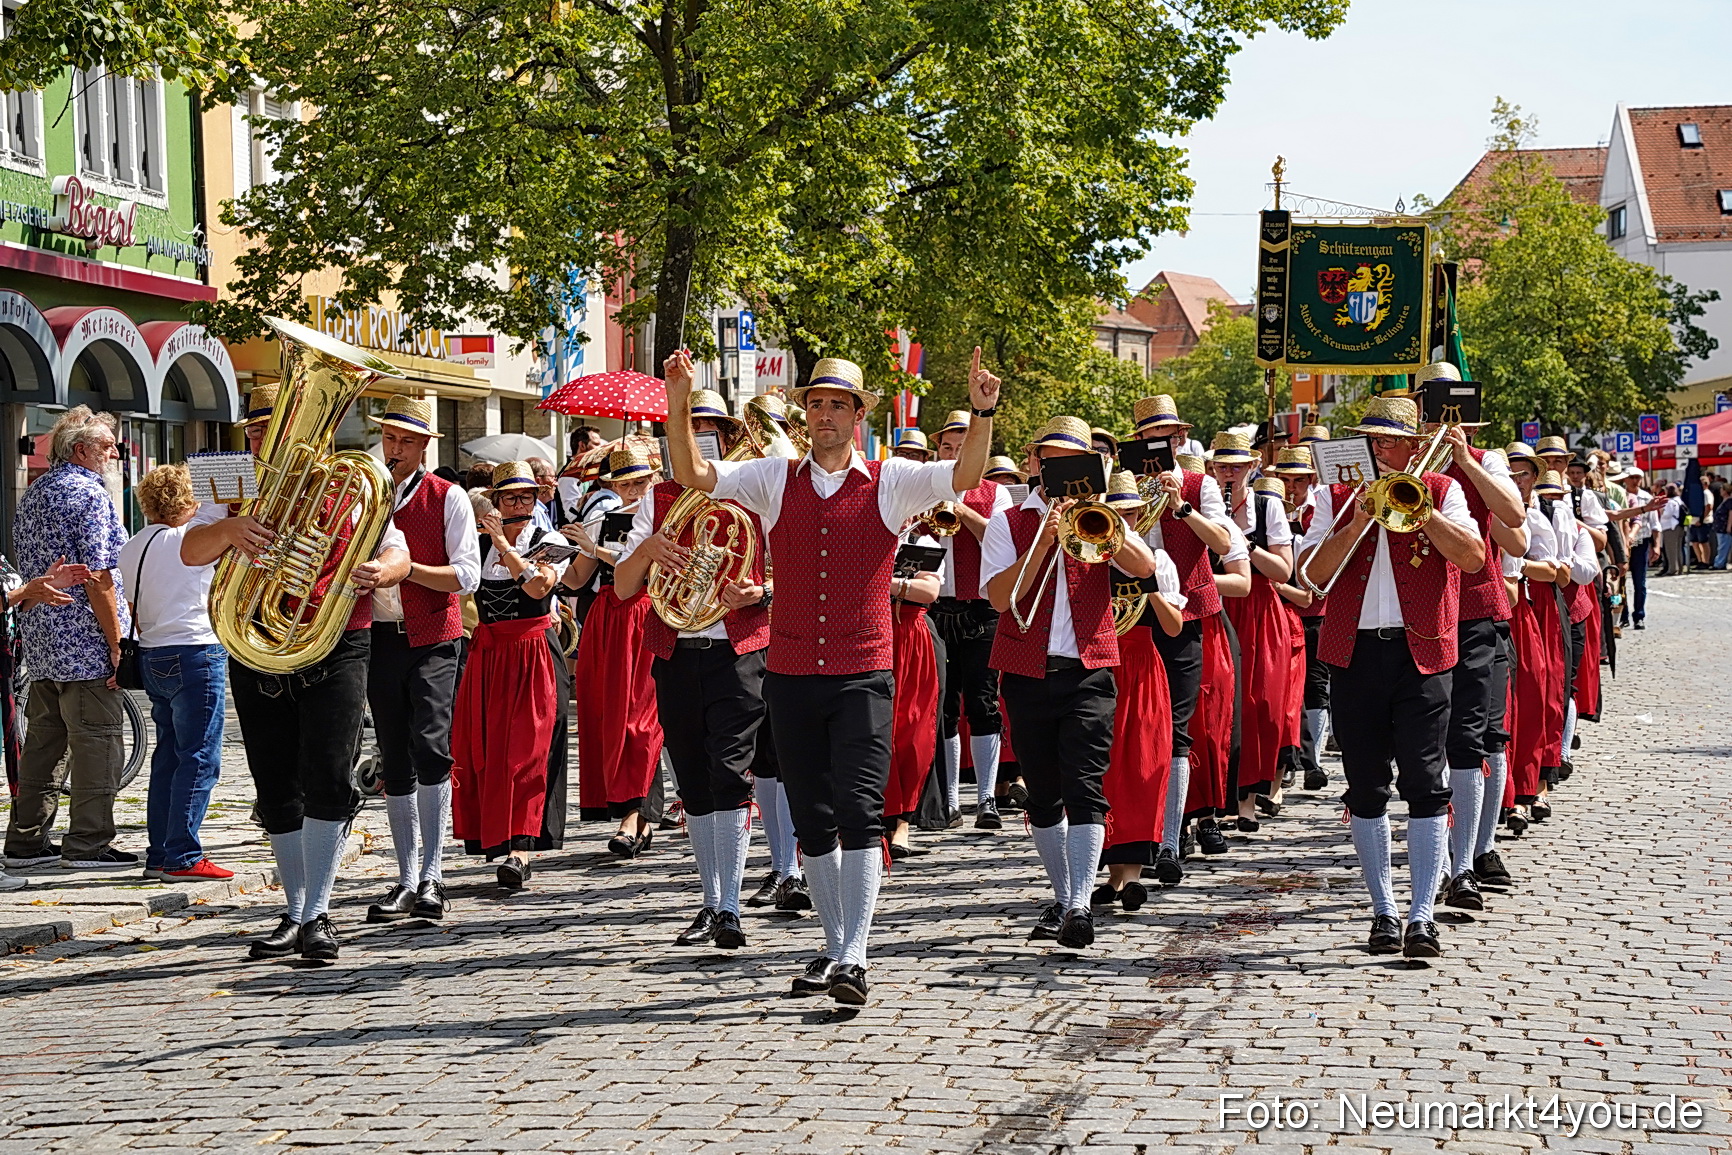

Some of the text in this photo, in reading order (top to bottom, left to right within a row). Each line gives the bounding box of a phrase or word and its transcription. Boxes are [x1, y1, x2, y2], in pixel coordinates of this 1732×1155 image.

[0, 199, 50, 230] ETZGEREI
[61, 176, 138, 249] Bögerl
[147, 235, 214, 267] AM MARKTPLATZ
[1318, 240, 1393, 259] Schützengau
[317, 296, 364, 345] LEDER
[467, 357, 490, 367] family
[756, 356, 783, 378] H&M
[1620, 435, 1631, 451] P
[1642, 435, 1659, 443] TAXI
[1681, 426, 1694, 444] P
